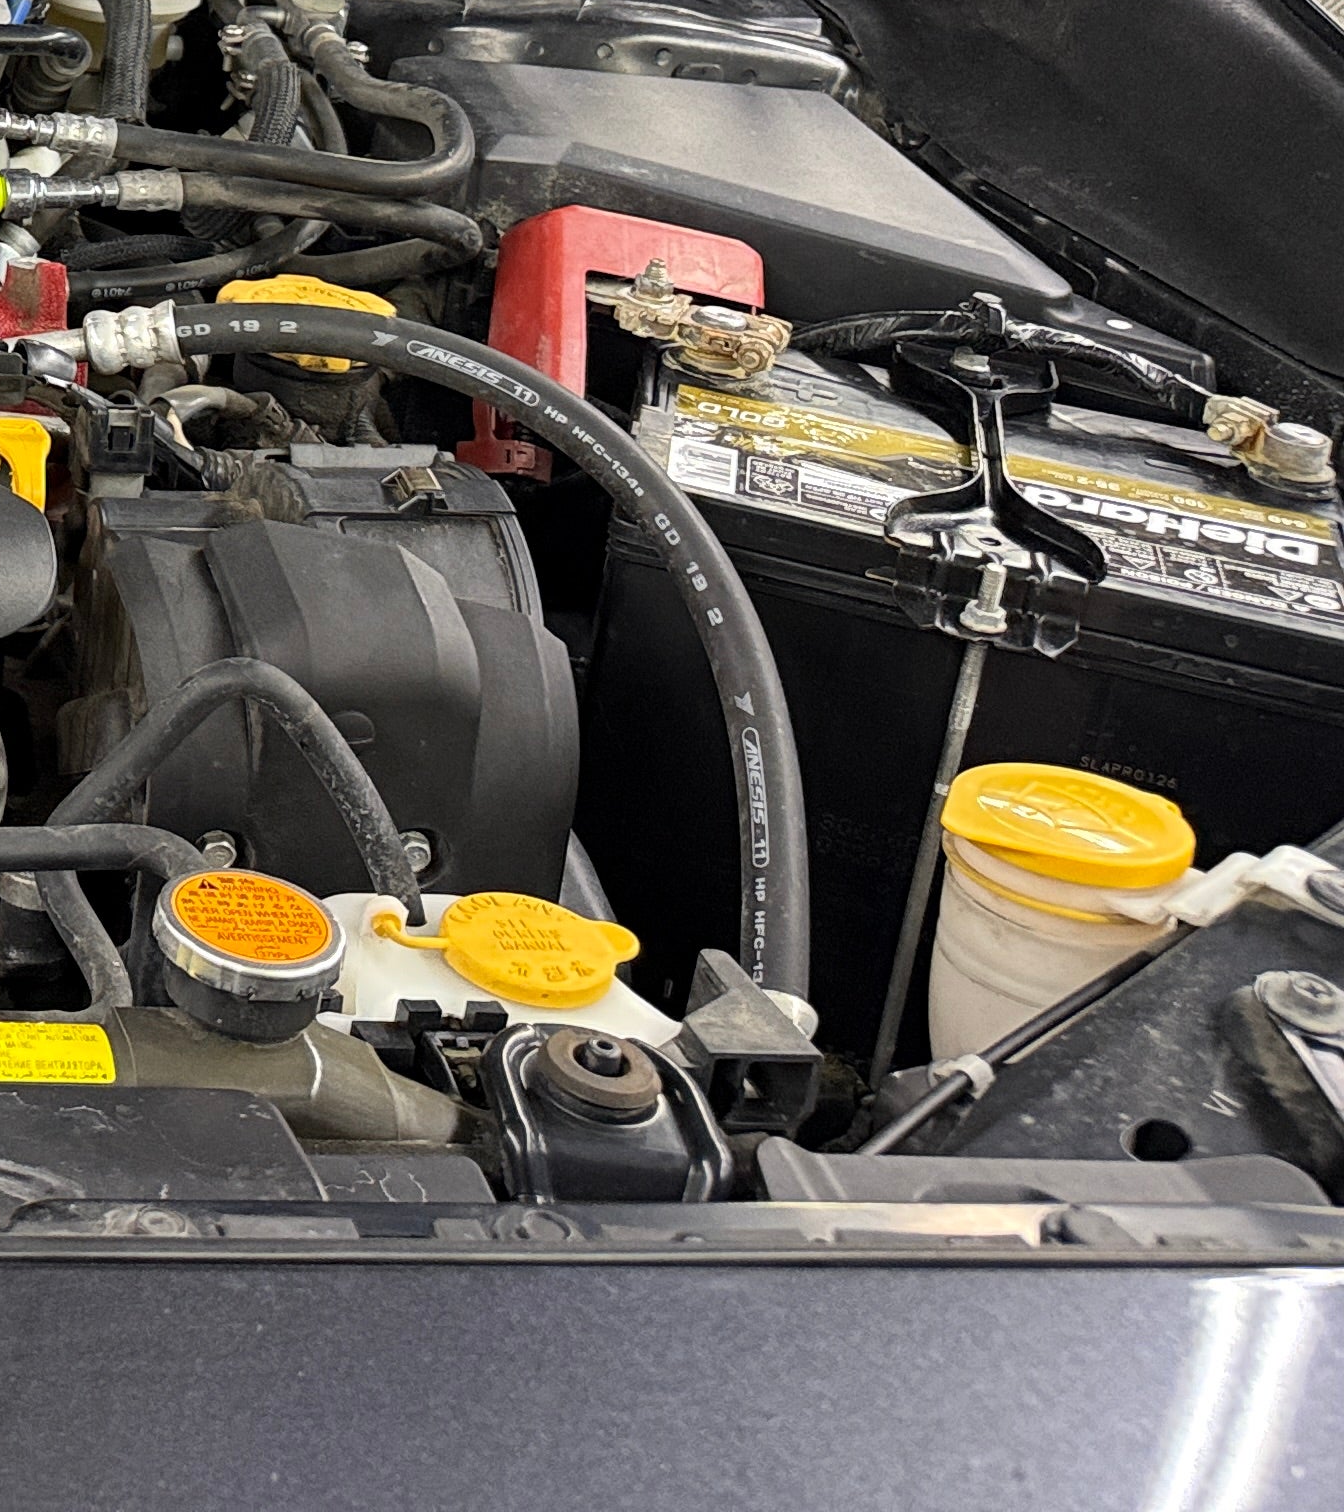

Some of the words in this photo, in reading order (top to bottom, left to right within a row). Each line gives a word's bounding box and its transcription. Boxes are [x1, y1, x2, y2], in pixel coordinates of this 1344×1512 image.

[176, 323, 212, 338] GD
[228, 319, 260, 333] 19
[279, 320, 299, 334] 2
[543, 405, 569, 425] HP
[654, 512, 681, 546] GD
[685, 561, 708, 592] 19
[706, 606, 725, 627] 2
[1022, 485, 1319, 566] DieHard
[753, 876, 767, 902] HP
[184, 905, 219, 915] NEVER
[255, 909, 290, 919] WHEN
